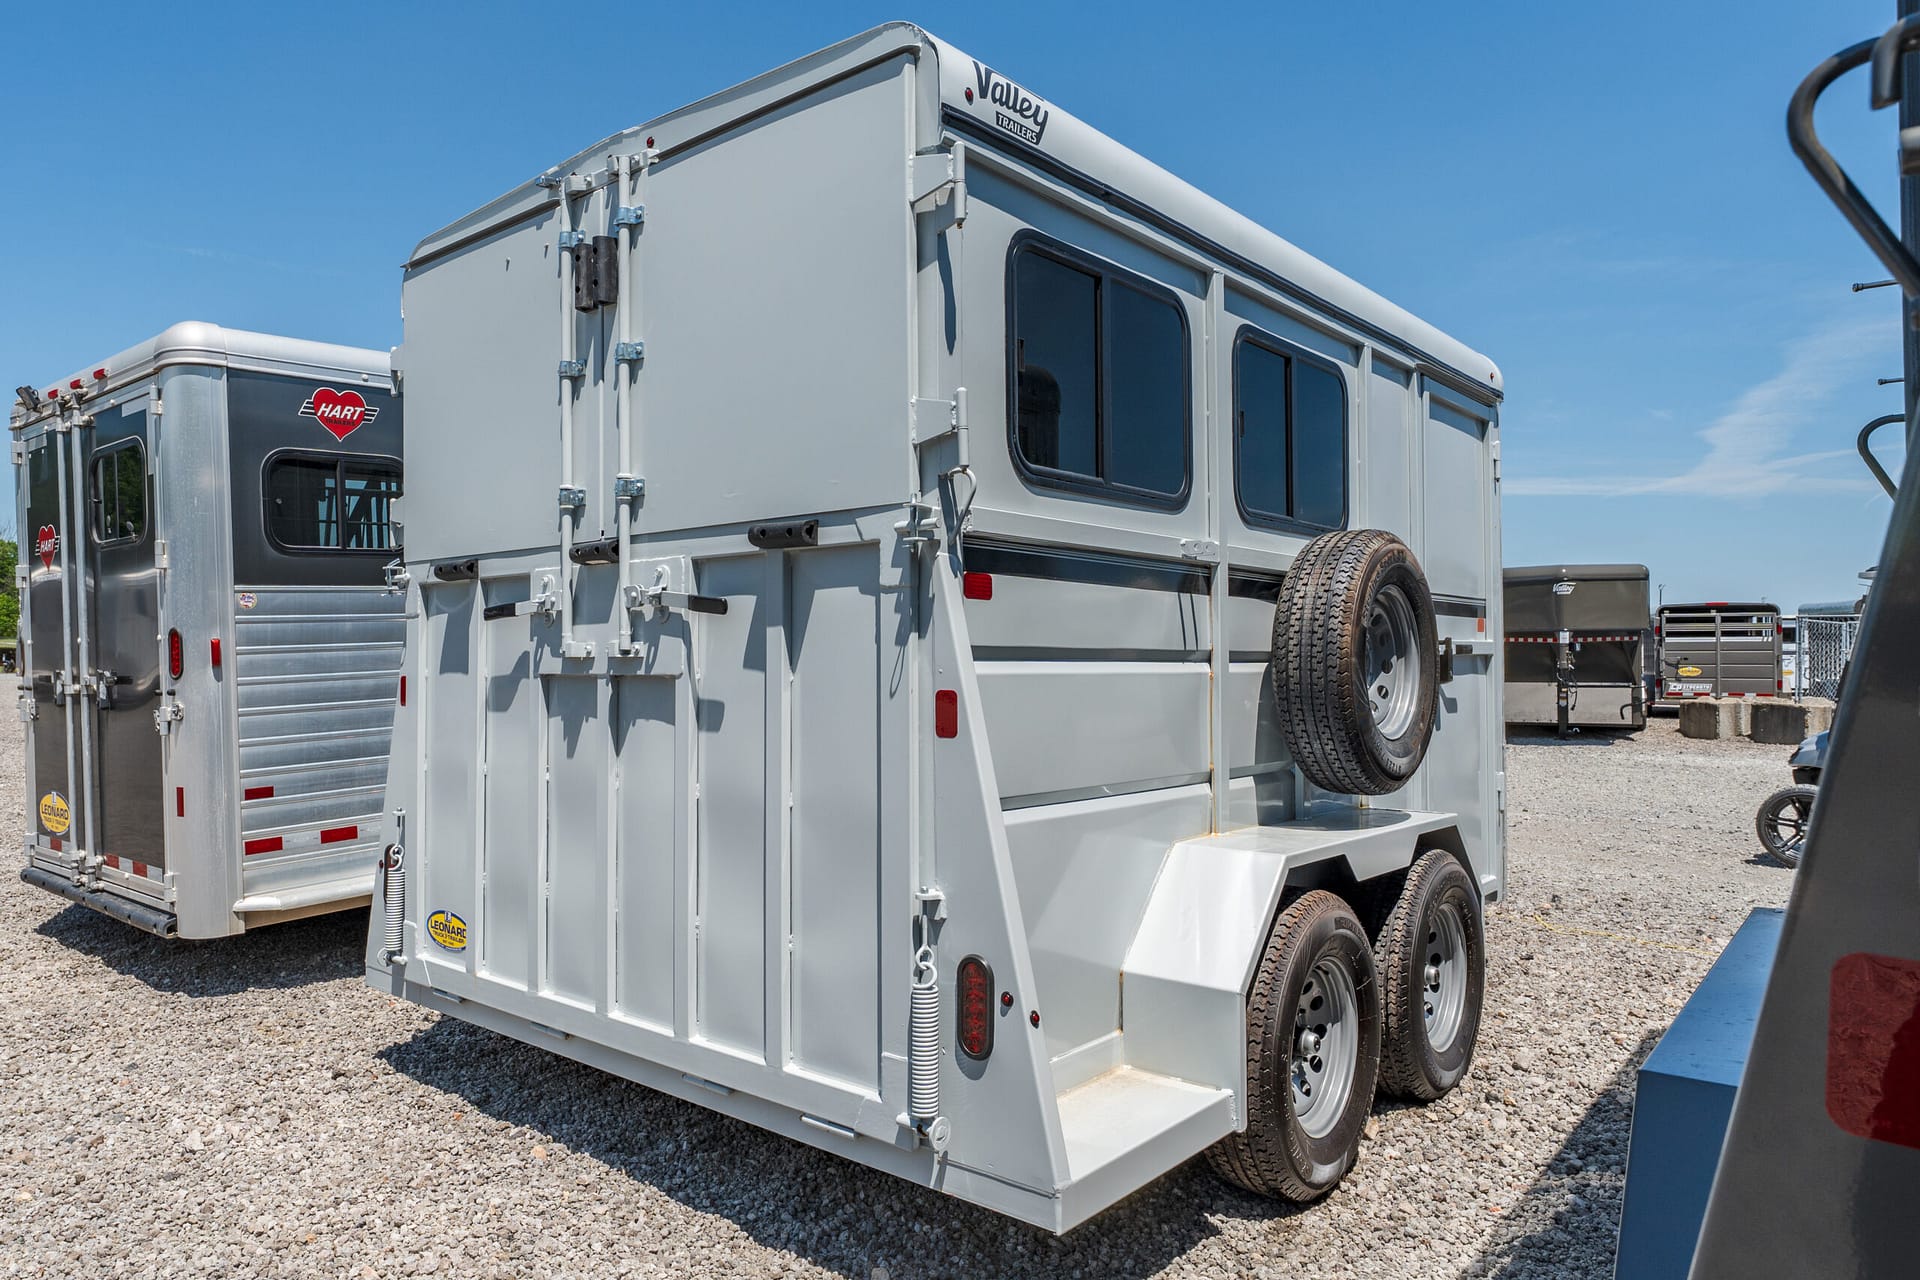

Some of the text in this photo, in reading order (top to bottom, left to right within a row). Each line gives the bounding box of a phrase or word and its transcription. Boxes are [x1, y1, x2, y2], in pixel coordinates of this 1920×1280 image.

[972, 60, 1049, 143] Valley
[997, 113, 1038, 144] TRAILERS
[317, 403, 366, 421] HART
[41, 803, 69, 820] LEONARD
